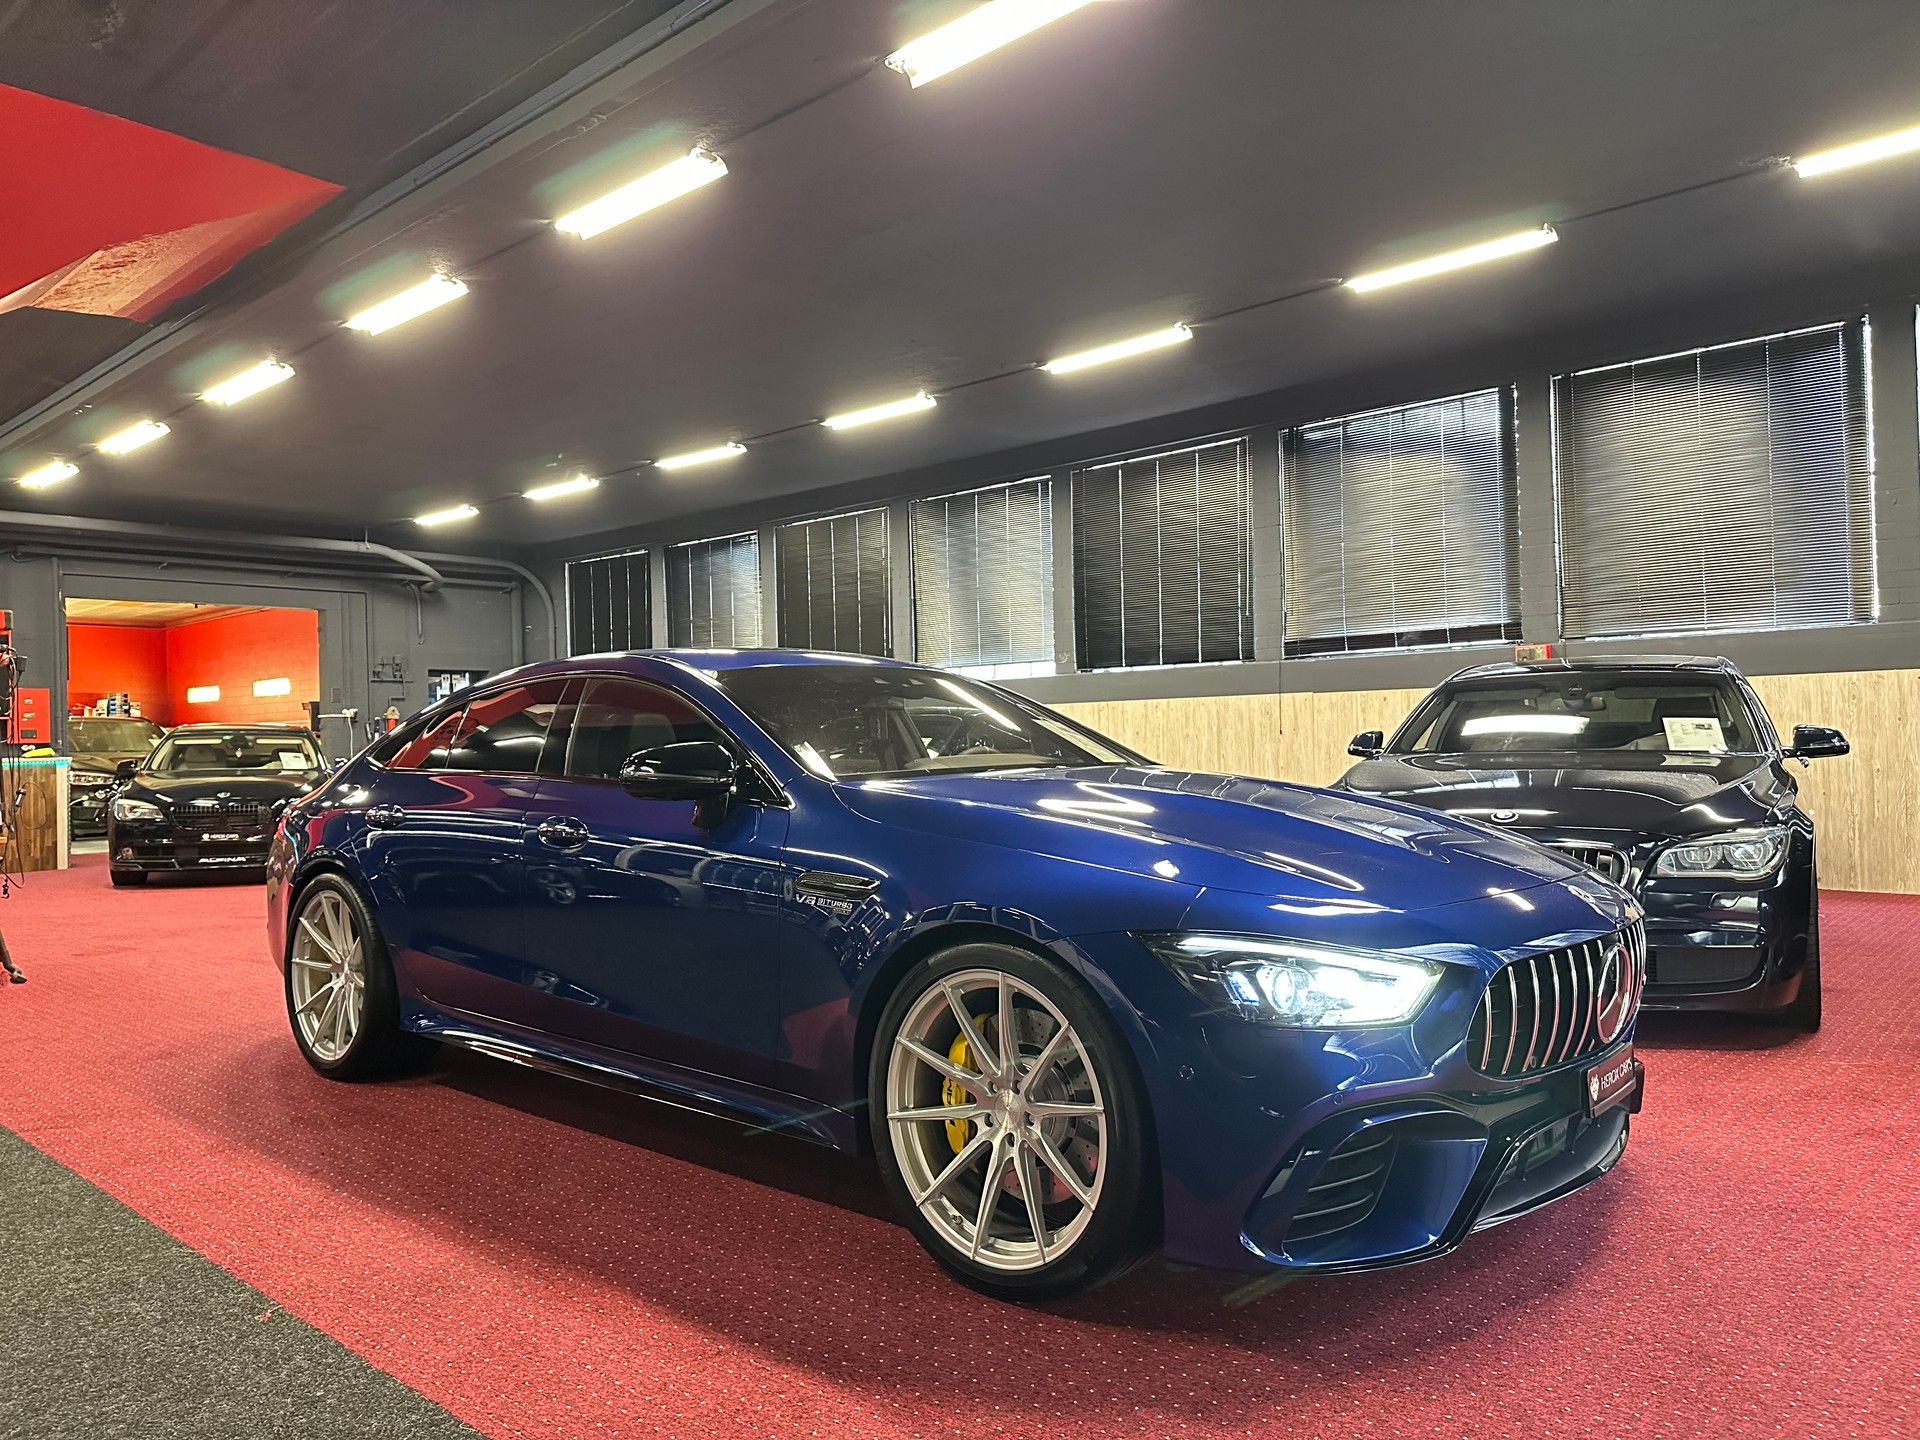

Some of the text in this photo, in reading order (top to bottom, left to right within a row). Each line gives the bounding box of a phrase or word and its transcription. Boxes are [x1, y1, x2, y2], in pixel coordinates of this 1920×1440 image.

[795, 894, 853, 909] V8 BITURBO
[1600, 1057, 1633, 1090] HEROX CARS
